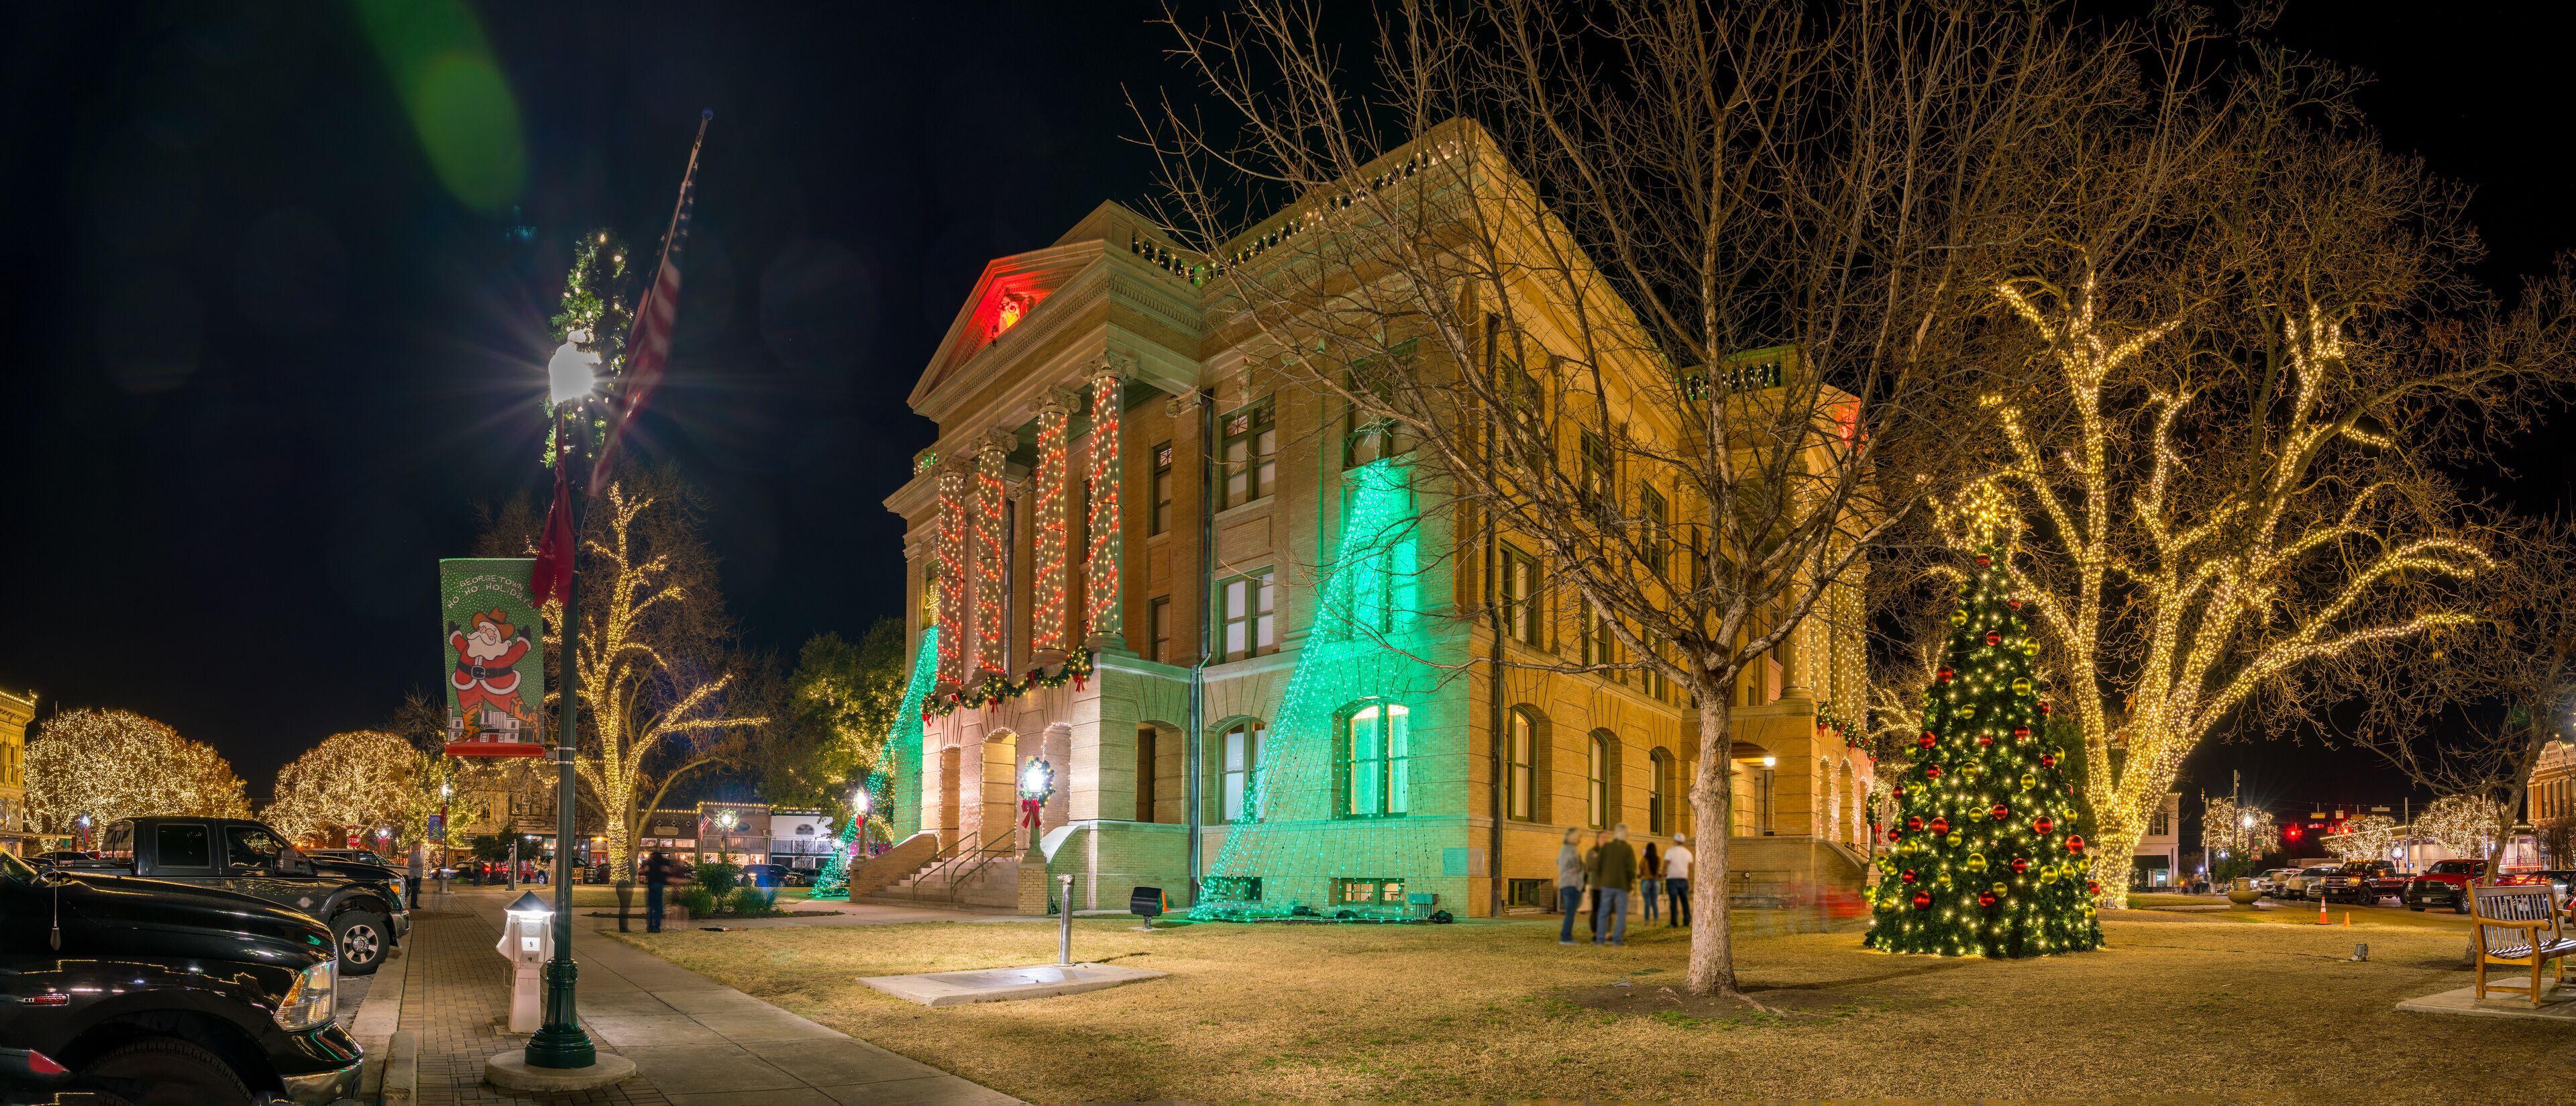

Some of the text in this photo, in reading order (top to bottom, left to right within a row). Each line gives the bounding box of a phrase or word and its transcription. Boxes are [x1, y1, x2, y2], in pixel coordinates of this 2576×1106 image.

[460, 575, 523, 591] GEORGETOWN
[447, 596, 460, 609] HO
[464, 586, 478, 595] HO
